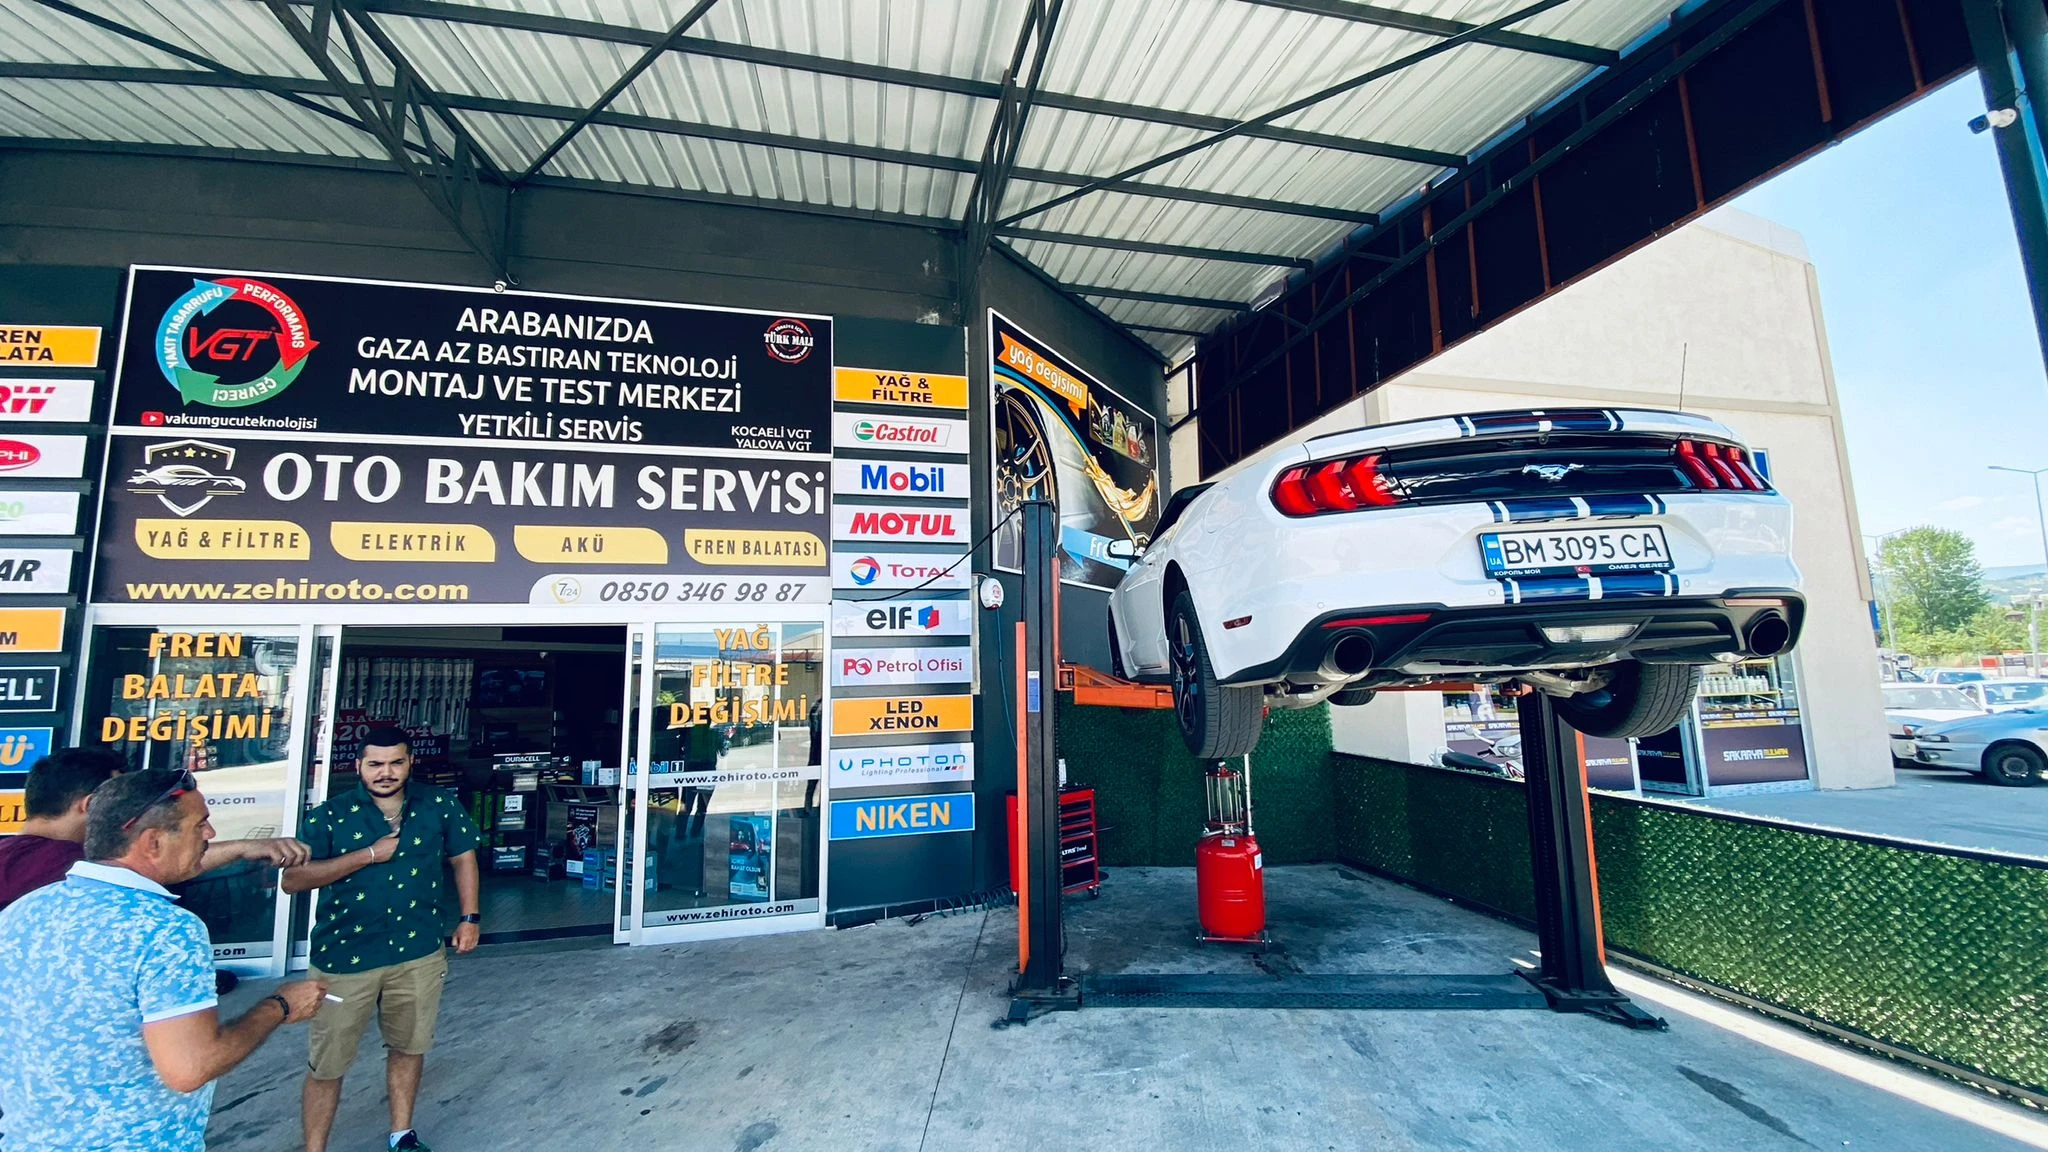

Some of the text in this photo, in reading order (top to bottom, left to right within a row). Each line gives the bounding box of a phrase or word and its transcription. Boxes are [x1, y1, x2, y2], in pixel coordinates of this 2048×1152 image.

[164, 286, 223, 369] YAKIT TASARRUFU
[243, 283, 306, 349] PERFORMANS
[456, 307, 654, 346] ARABANIZDA
[189, 326, 273, 362] VGT
[764, 330, 790, 345] TÜRK
[357, 336, 738, 380] GAZA AZ BASTIRAN TEKNOLOJİ
[875, 374, 930, 389] YAĞ &
[1009, 344, 1083, 401] yağ değişimi
[348, 368, 742, 413] MONTAJ VE TEST MERKEZİ
[872, 387, 933, 404] FİLTRE
[165, 412, 318, 430] vakumgucuteknolojisi
[458, 410, 644, 442] YETKİLİ SERVİS
[731, 425, 812, 440] KOCAELİ VGT
[876, 423, 938, 443] Castrol
[735, 437, 812, 451] YALOVA VGT
[263, 452, 401, 504] OTO
[425, 458, 615, 508] BAKIM
[861, 464, 945, 493] Mobil
[849, 512, 956, 536] MOTUL
[147, 527, 300, 550] YAĞ & FİLTRE
[361, 529, 466, 552] ELEKTRİK
[560, 532, 606, 554] AKÜ
[693, 538, 818, 557] FREN BALATASI
[1502, 533, 1662, 565] BM 3095 CA
[1490, 556, 1503, 567] UA
[126, 578, 470, 602] www.zehiroto.com
[600, 582, 668, 602] 0850
[677, 582, 727, 602] 346
[734, 582, 768, 602] 98
[775, 582, 807, 602] 87
[866, 606, 912, 630] elf
[148, 631, 242, 658] FREN
[714, 623, 770, 651] YAĞ
[692, 660, 789, 688] FİLTRE
[877, 659, 923, 673] Petrol
[927, 658, 963, 671] Ofisi
[122, 672, 260, 700] BALATA
[669, 693, 807, 729] DEĞİŞİMİ
[886, 700, 923, 715] LED
[101, 707, 273, 748] DEĞİŞİMİ
[869, 715, 939, 730] XENON
[1722, 749, 1764, 762] SAKARYA
[673, 769, 800, 785] www.zehiroto.com
[861, 766, 943, 777] Lighting Professional
[856, 801, 951, 832] NIKEN
[666, 902, 795, 923] www.zehiroto.com
